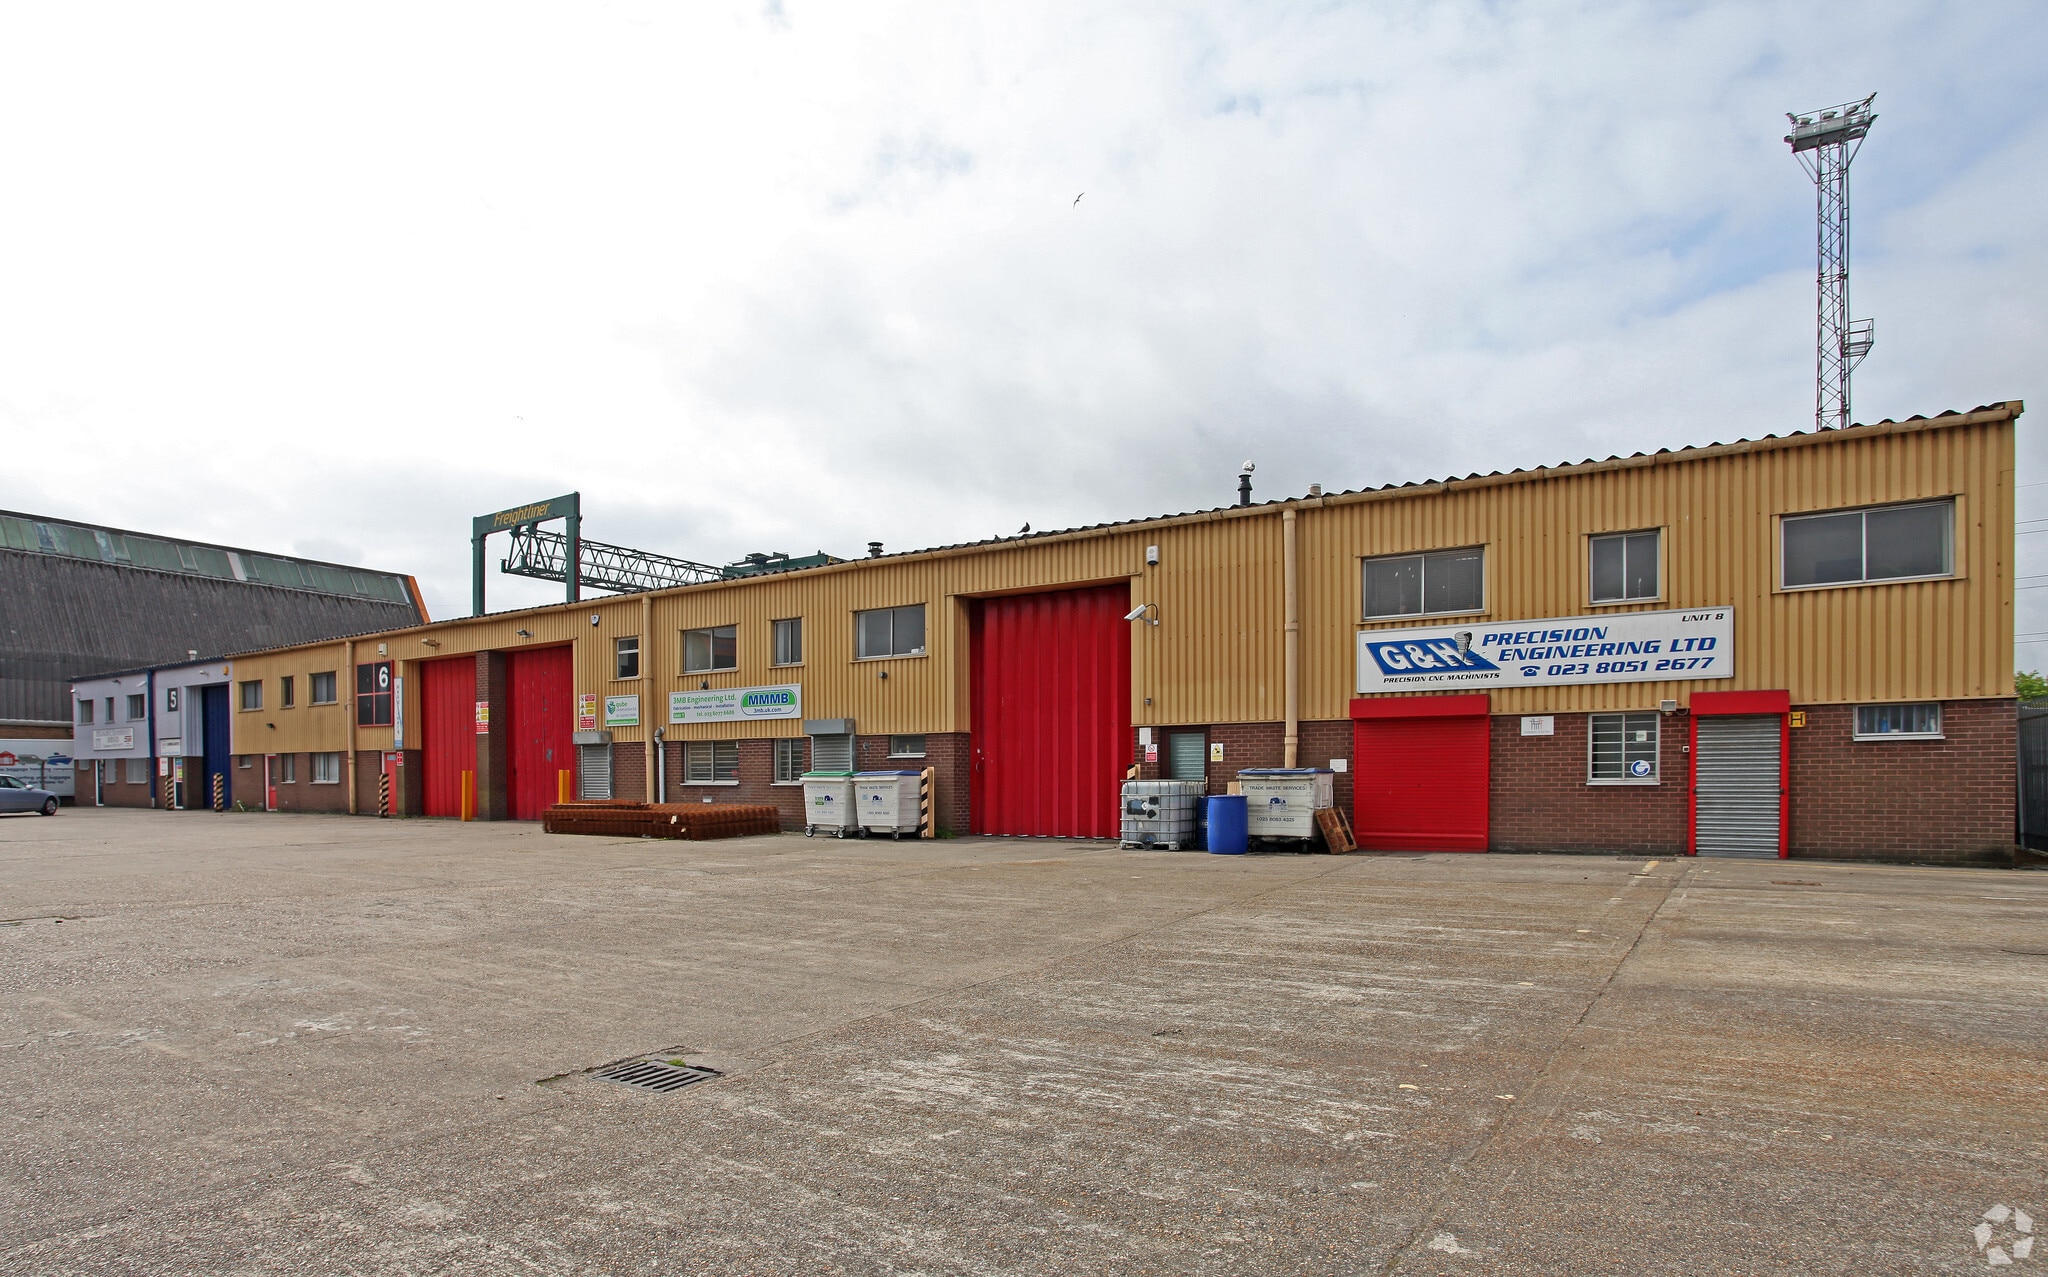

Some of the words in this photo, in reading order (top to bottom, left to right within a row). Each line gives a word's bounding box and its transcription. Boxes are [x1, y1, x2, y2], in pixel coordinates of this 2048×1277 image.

[494, 502, 550, 526] Freightliner
[1681, 613, 1712, 622] UNIT
[1481, 626, 1609, 647] PRECISION
[1379, 641, 1476, 670] G&H
[1498, 640, 1662, 662] ENGINEERING
[1669, 637, 1717, 652] LTD
[1547, 663, 1590, 676] 023
[1595, 660, 1648, 673] 8051
[1655, 656, 1715, 671] 2677
[379, 666, 389, 688] 6
[1383, 676, 1427, 684] PRECISION
[1447, 672, 1500, 681] MACHINISTS
[170, 690, 177, 708] 5
[687, 694, 724, 705] Engineering
[724, 693, 737, 701] Ltd.
[748, 693, 789, 705] MMMB
